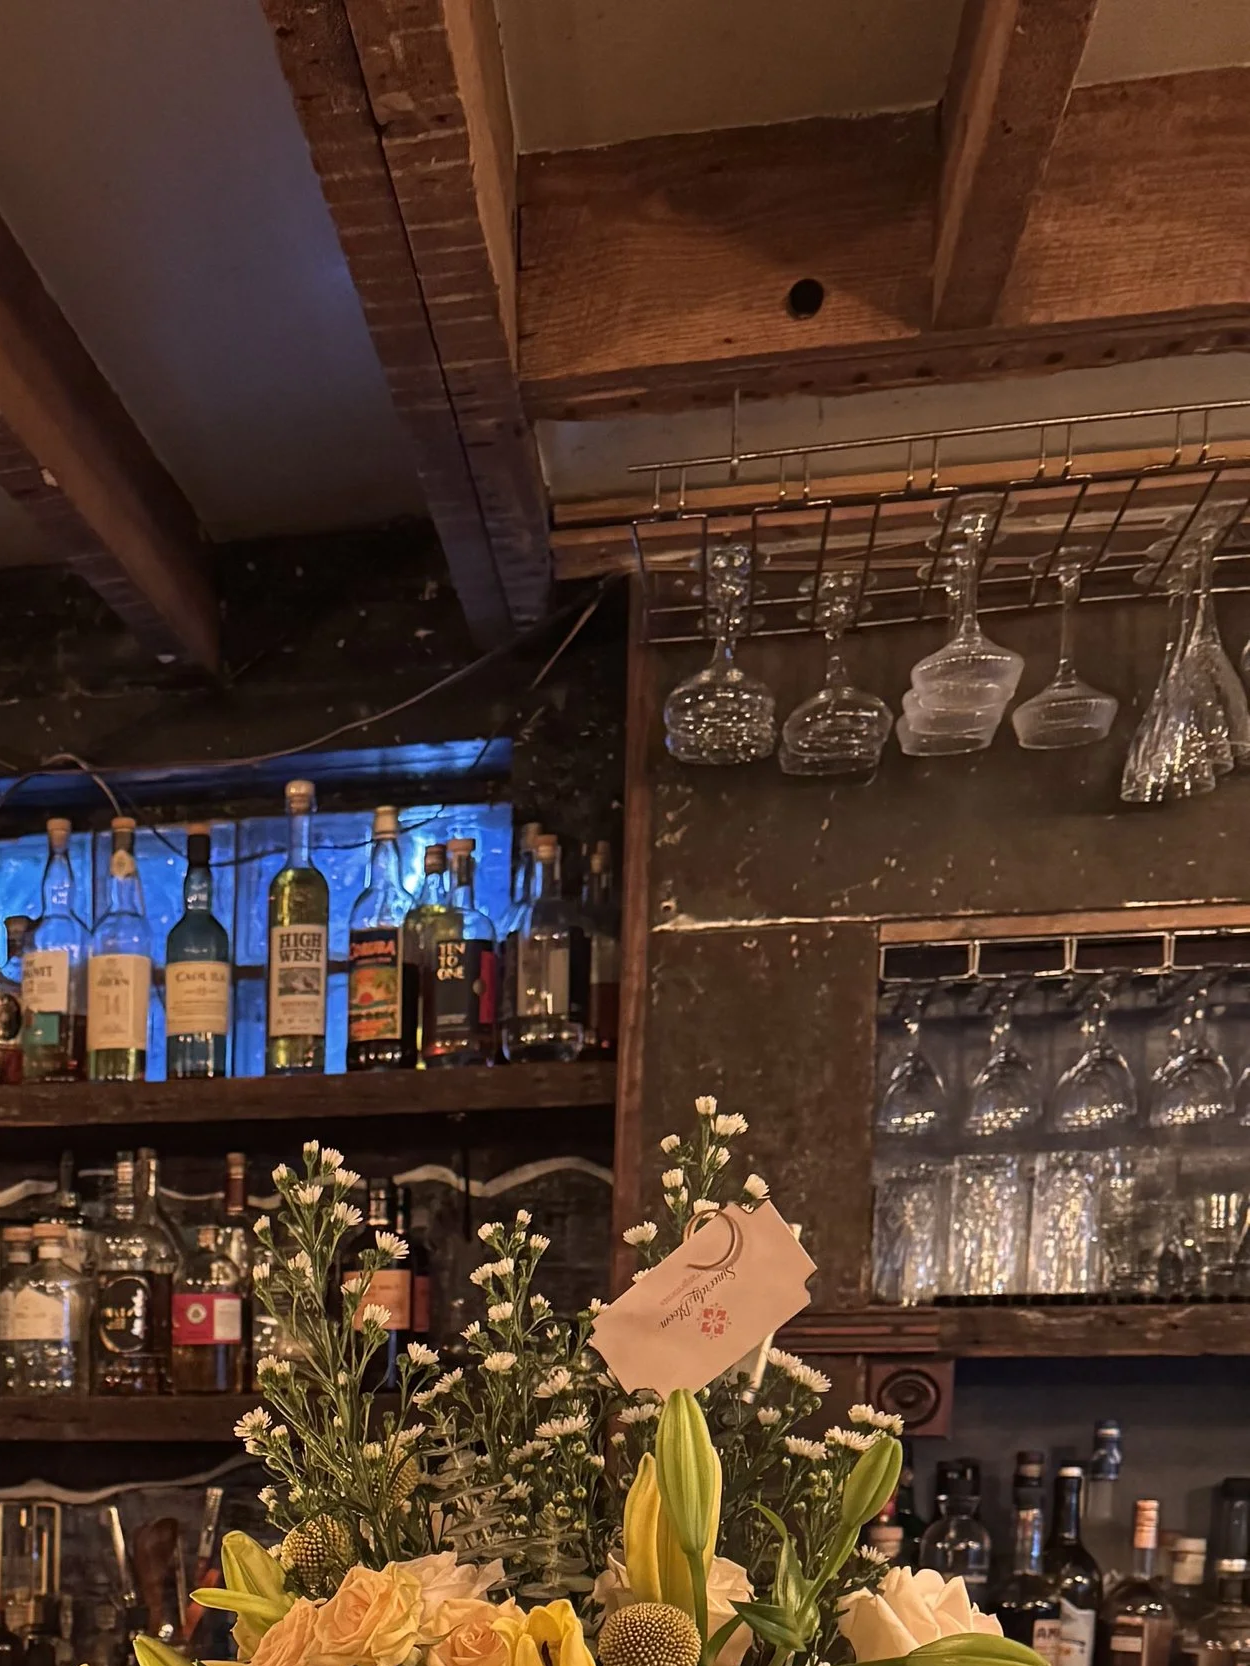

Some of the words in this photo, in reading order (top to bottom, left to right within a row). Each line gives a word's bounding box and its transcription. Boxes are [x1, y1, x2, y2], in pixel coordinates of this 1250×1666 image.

[279, 933, 322, 950] HIGH
[439, 943, 466, 955] TEN
[279, 950, 322, 963] WEST
[439, 956, 457, 967] TO
[437, 967, 466, 981] ONE
